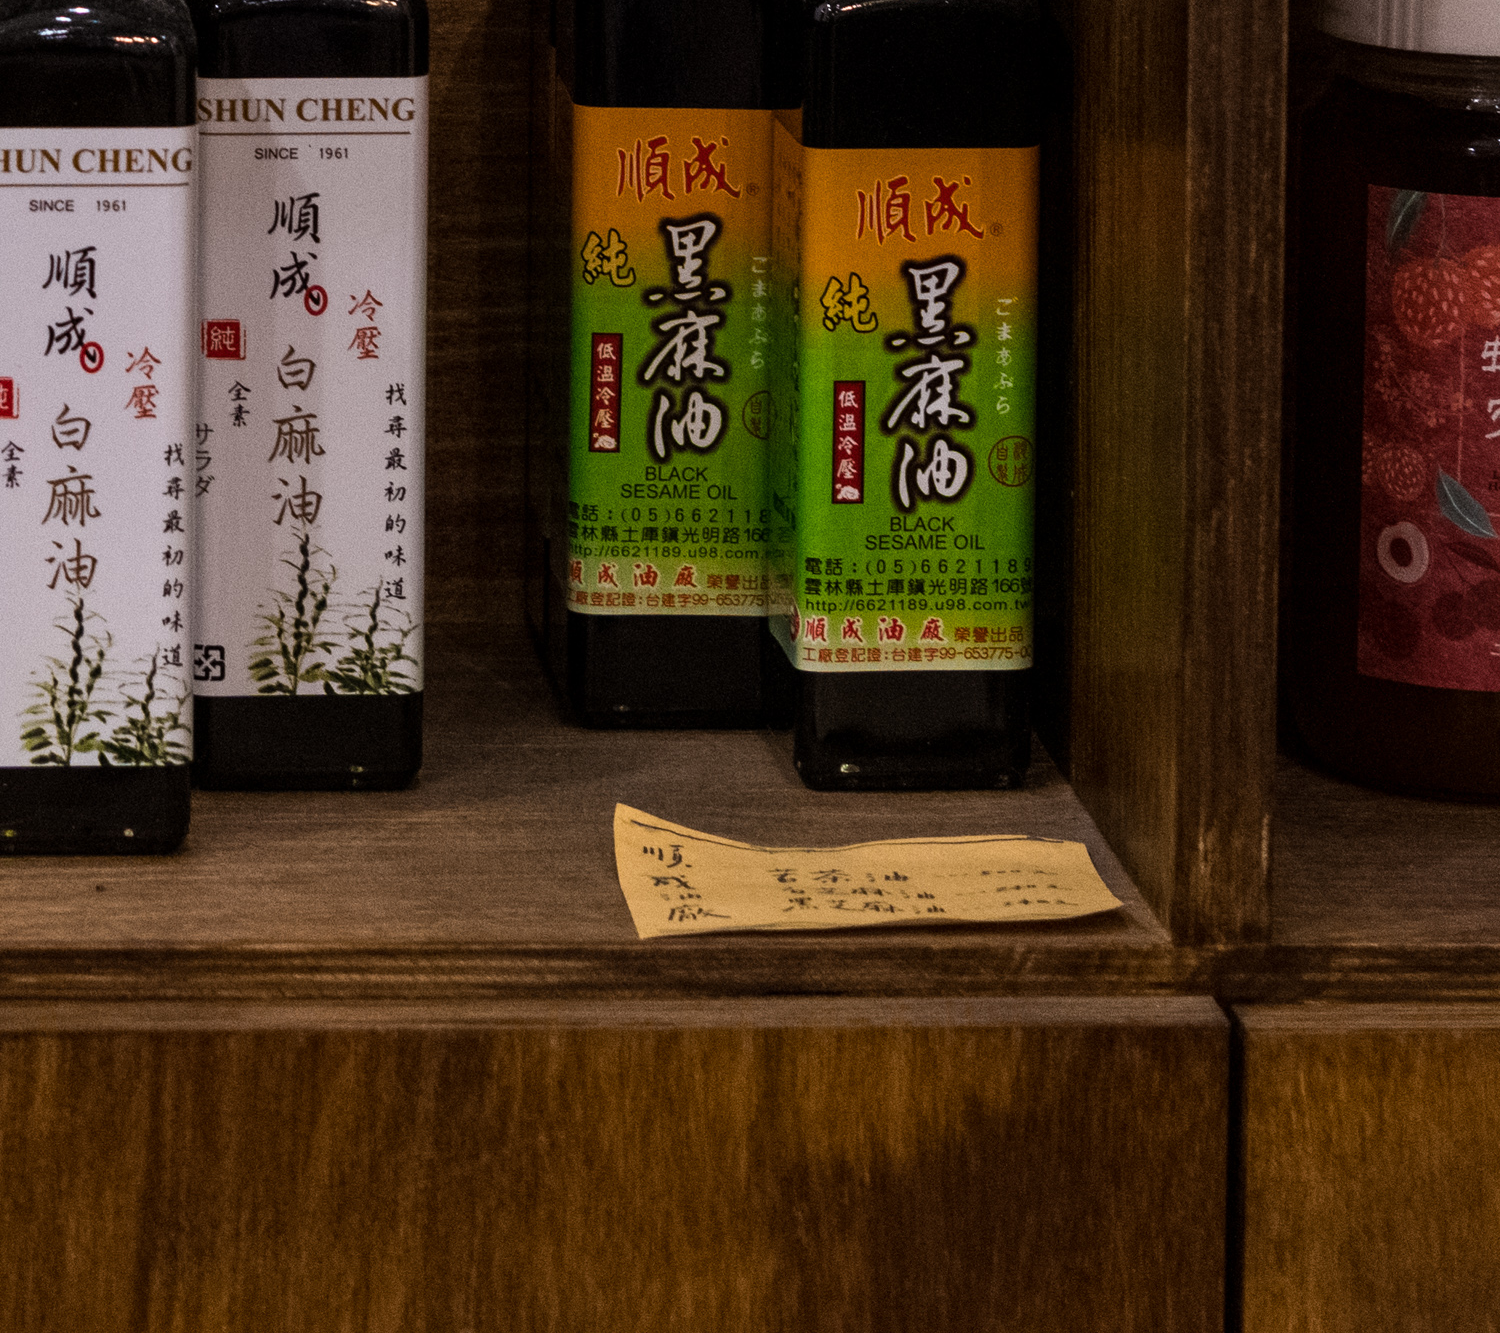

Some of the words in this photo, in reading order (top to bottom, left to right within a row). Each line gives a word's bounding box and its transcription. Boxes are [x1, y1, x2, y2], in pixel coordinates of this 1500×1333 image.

[197, 95, 288, 124] SHUN
[295, 95, 417, 124] CHENG
[72, 147, 195, 177] CHENG
[253, 146, 300, 161] SINCE
[317, 146, 351, 161] 1961
[615, 133, 743, 203] 順成
[28, 198, 76, 214] SINCE
[95, 197, 129, 214] 1961
[856, 175, 987, 245] 順成
[266, 190, 322, 309] 順成
[41, 245, 101, 366] 順成
[346, 288, 385, 362] 冷壓
[819, 271, 879, 334] 純
[642, 217, 728, 460] 黑麻油
[125, 345, 162, 421] 冷壓
[226, 379, 252, 429] 全素
[887, 261, 972, 509] 黑麻油
[0, 440, 25, 490] 全素
[195, 421, 215, 500] サラダ
[266, 343, 326, 529] 白麻油
[40, 402, 102, 592] 白麻油
[383, 382, 408, 602] 找尋最初的味道
[620, 483, 702, 500] SESAME
[706, 483, 738, 501] OIL
[644, 465, 709, 482] BLACK
[161, 442, 187, 670] 找尋最初的味道
[864, 534, 947, 551] SESAME
[953, 534, 986, 551] OIL
[889, 516, 955, 533] BLACK
[804, 616, 946, 643] 順成油廠
